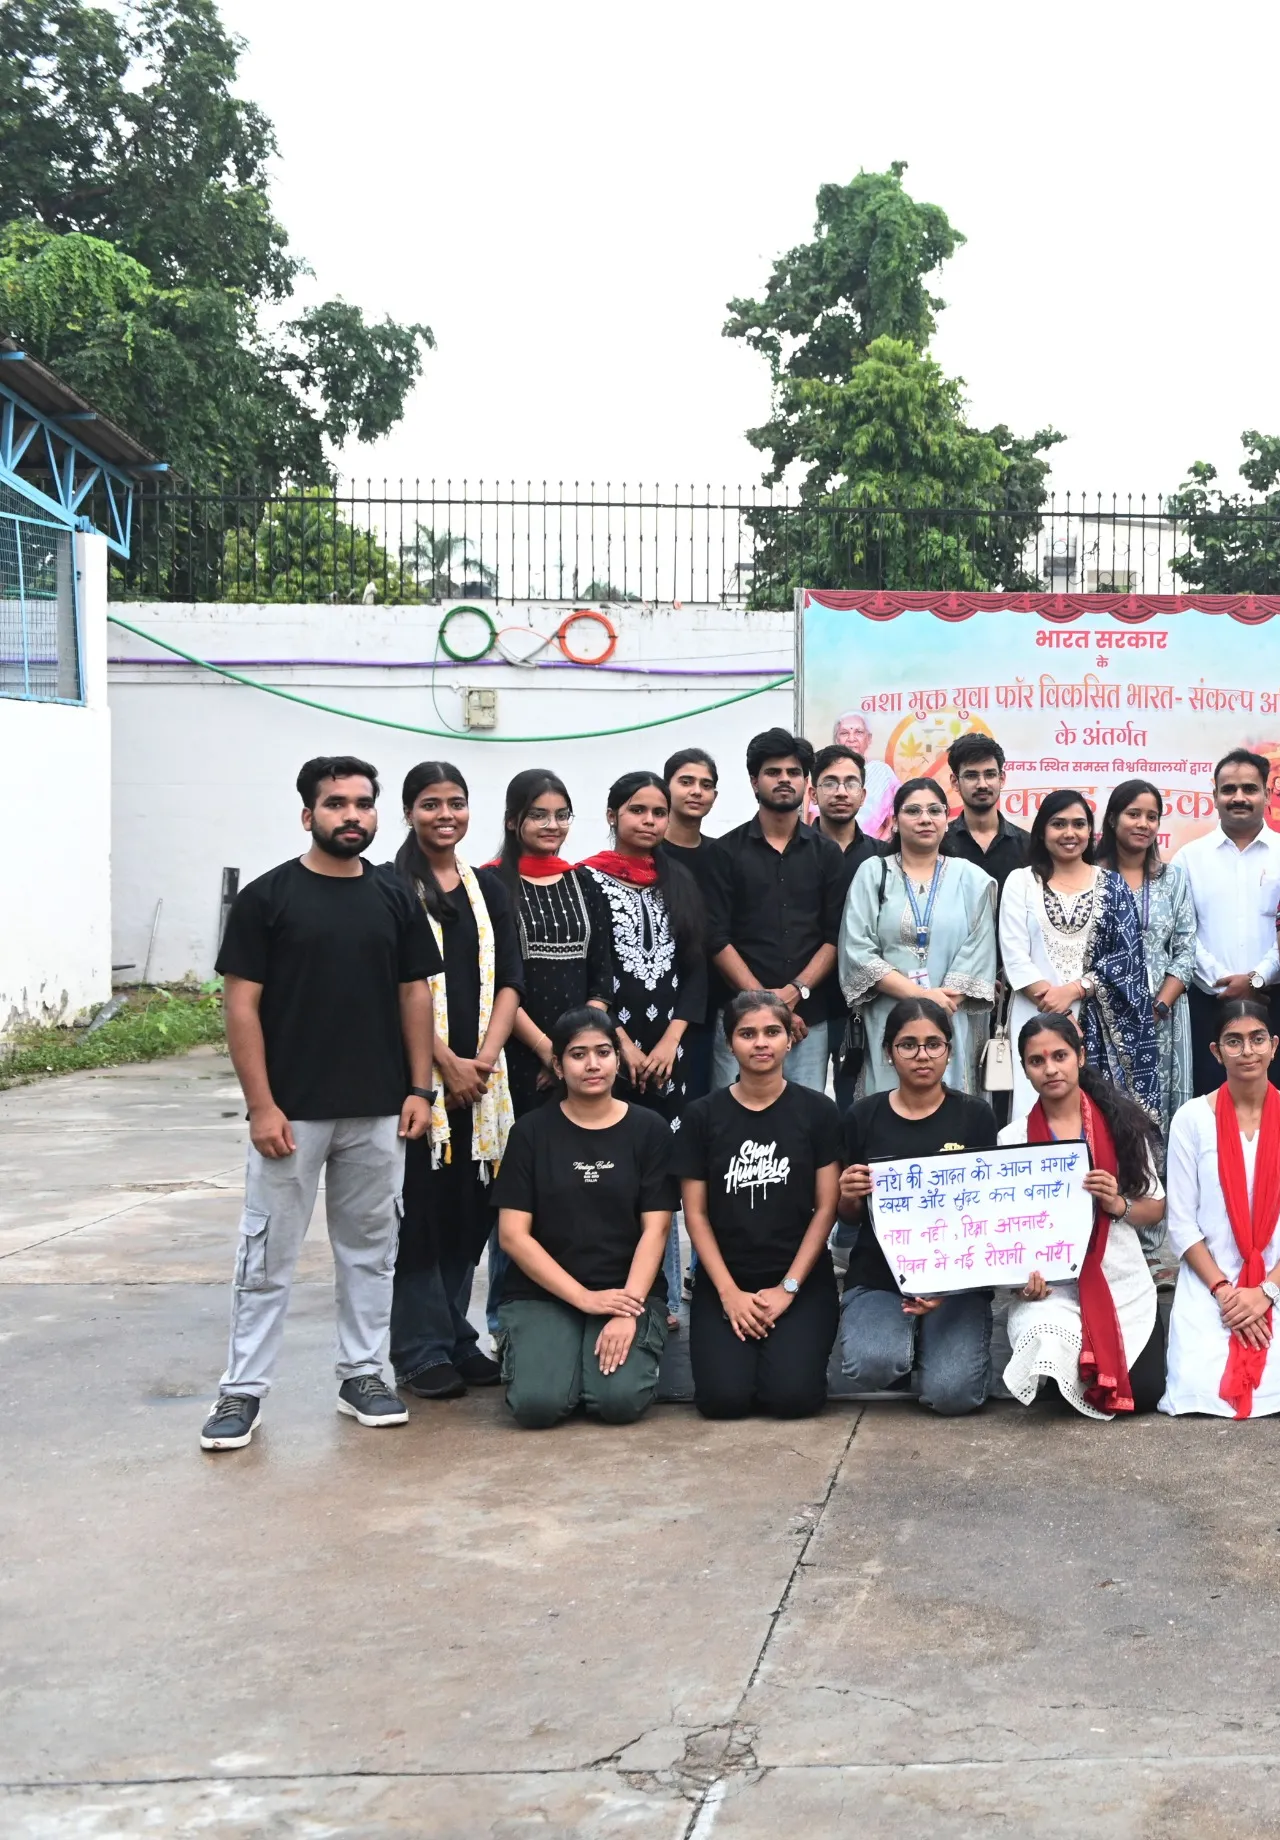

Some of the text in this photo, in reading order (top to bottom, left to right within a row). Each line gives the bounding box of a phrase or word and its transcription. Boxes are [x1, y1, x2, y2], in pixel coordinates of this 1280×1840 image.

[1035, 630, 1169, 649] भारत सरकार
[1096, 655, 1109, 668] के
[860, 692, 903, 713] नशा
[908, 688, 948, 720] मुक्त
[952, 686, 991, 720] युवा
[995, 676, 1035, 709] फॉर
[1039, 673, 1122, 709] विकसित
[1188, 678, 1254, 712] संकल्प
[1054, 720, 1148, 747] के अंतर्गत
[1001, 757, 1213, 776] खनऊ स्थित समस्त विश्वविद्यालयों द्वारा
[876, 1167, 902, 1192] नशे
[906, 1164, 923, 1189] की
[927, 1167, 967, 1186] आदत
[971, 1158, 992, 1181] को
[997, 1161, 1032, 1177] आज
[917, 1188, 946, 1209] और
[989, 1187, 1016, 1202] कल
[883, 1229, 912, 1246] नशा
[954, 1245, 975, 1270] नई
[985, 1241, 1026, 1266] रोशनी
